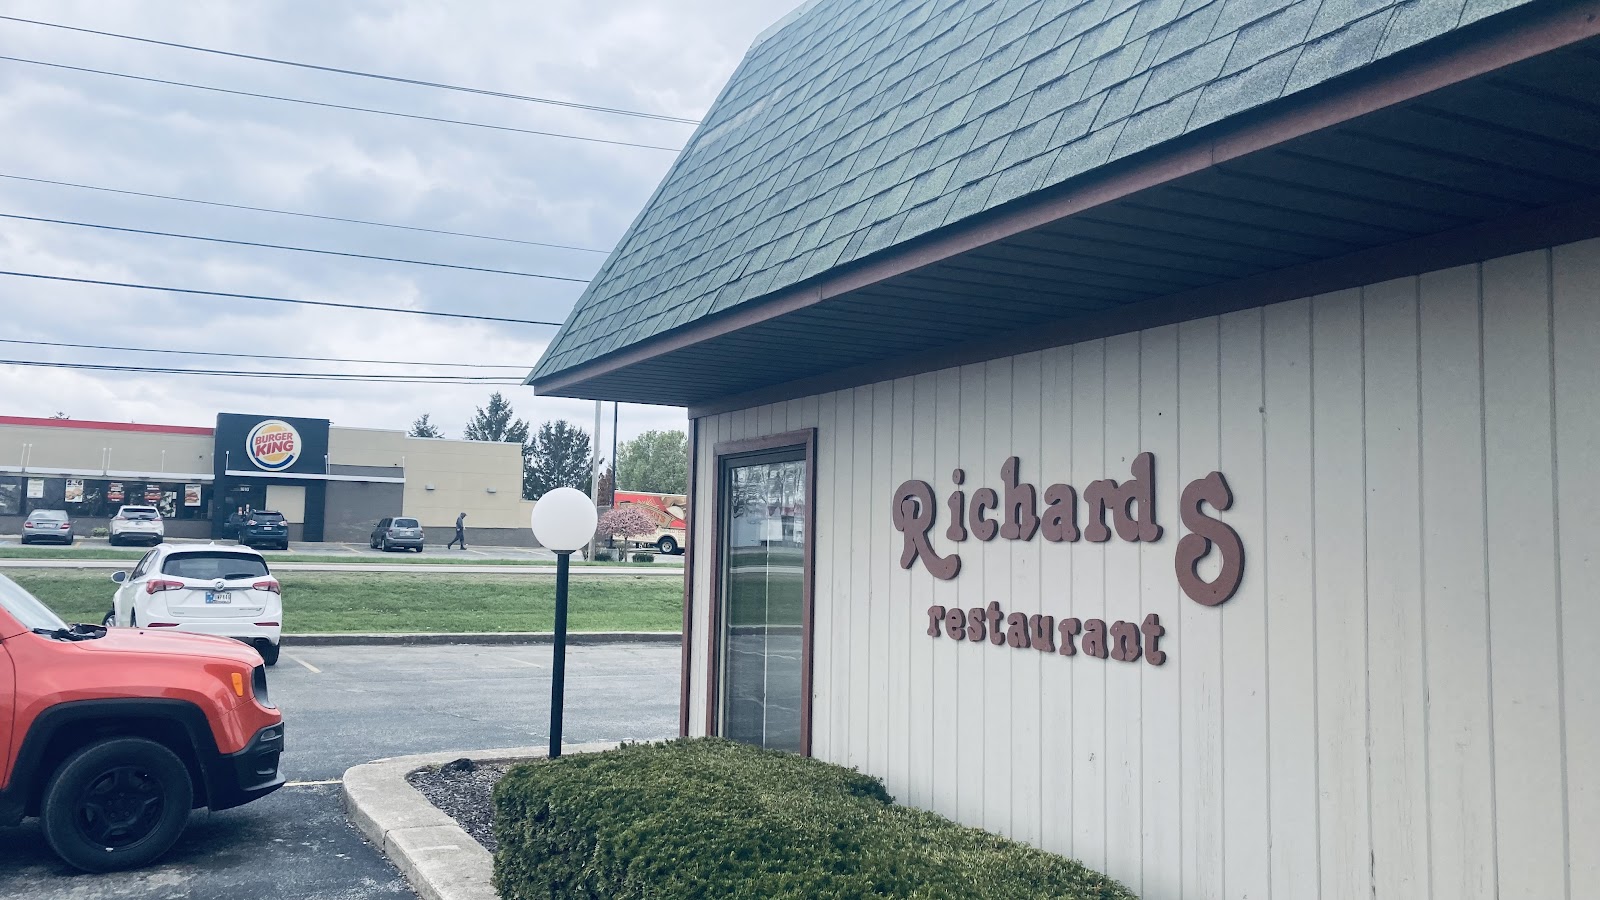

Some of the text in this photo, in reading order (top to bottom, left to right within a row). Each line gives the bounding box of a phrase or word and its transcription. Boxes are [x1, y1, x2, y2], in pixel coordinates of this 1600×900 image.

[255, 433, 293, 445] BURGER
[256, 441, 294, 457] KING
[926, 600, 1167, 666] restaurant
